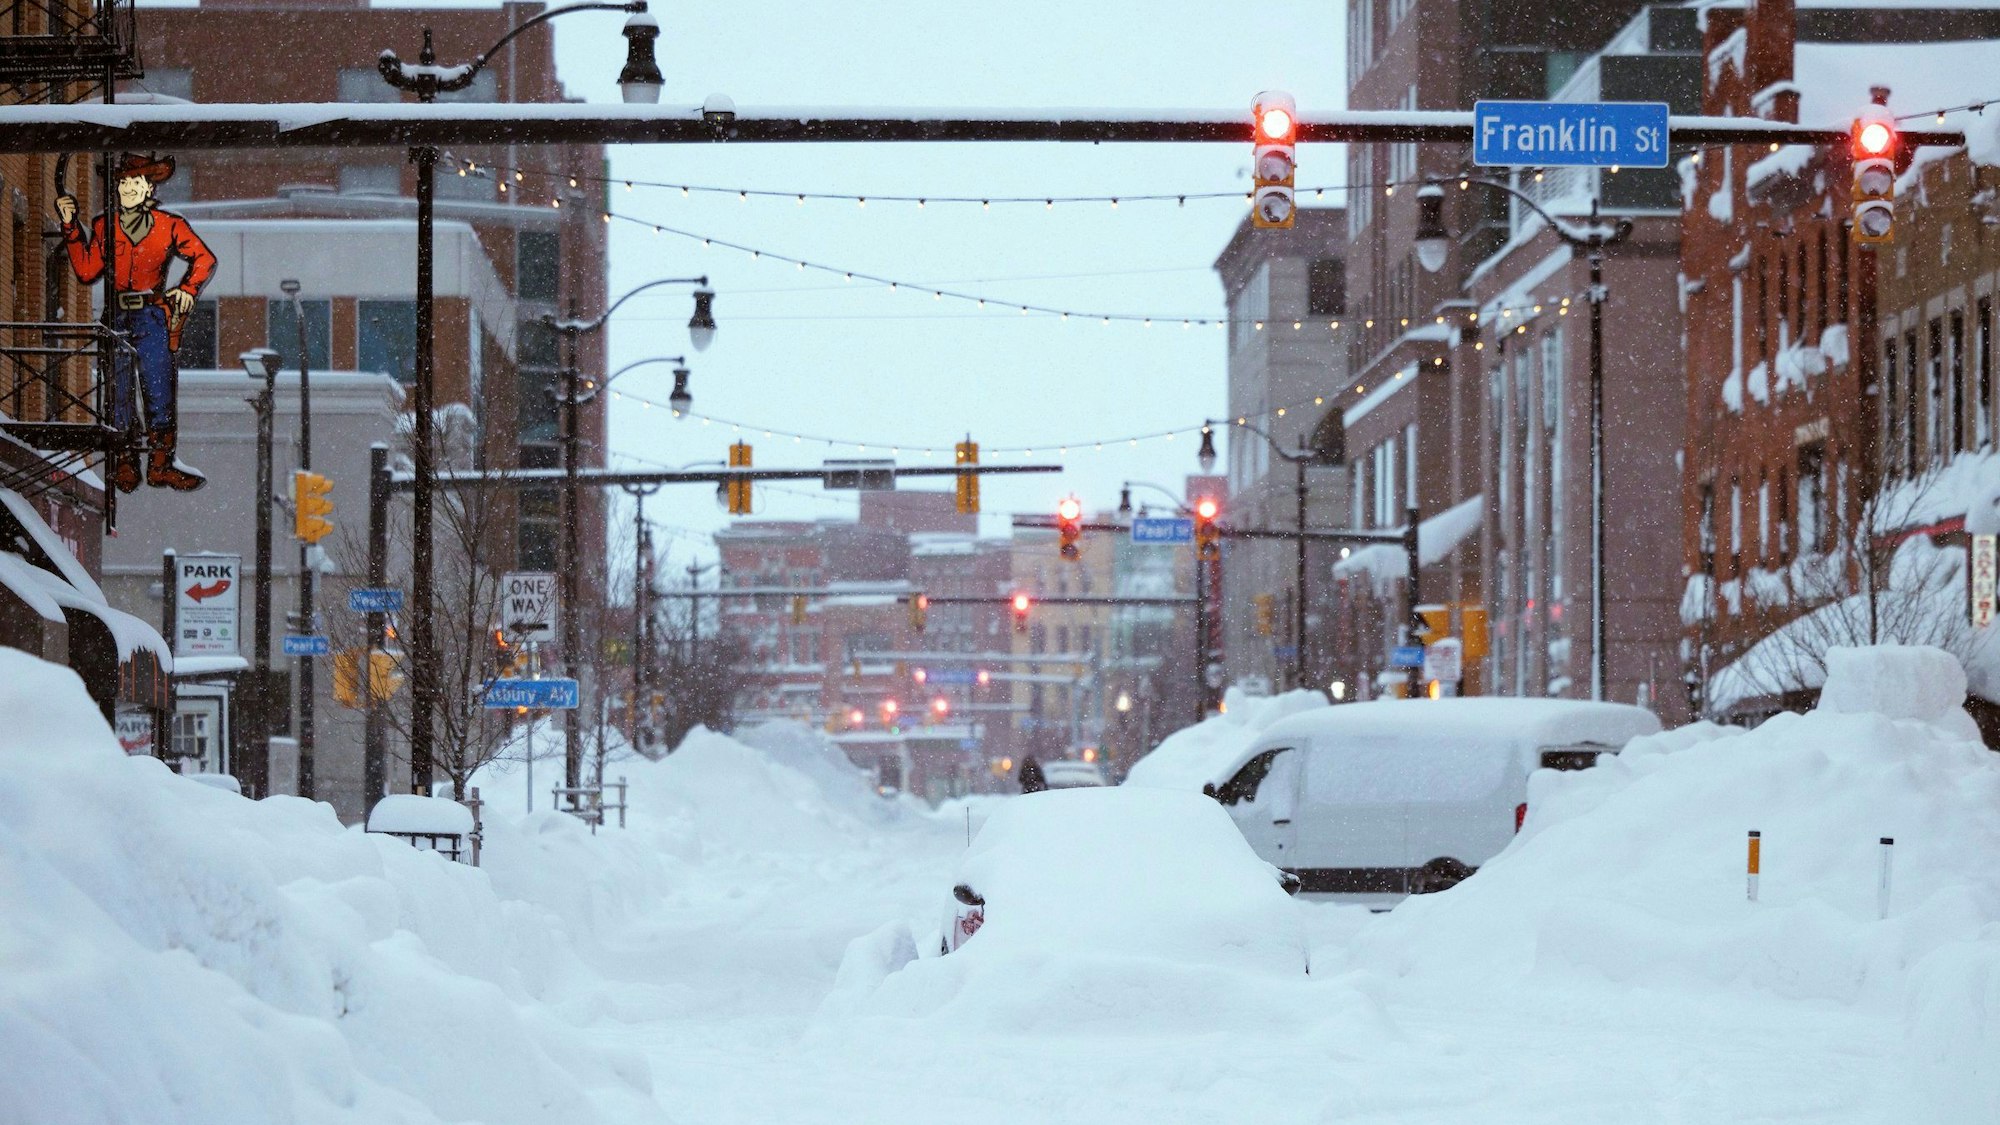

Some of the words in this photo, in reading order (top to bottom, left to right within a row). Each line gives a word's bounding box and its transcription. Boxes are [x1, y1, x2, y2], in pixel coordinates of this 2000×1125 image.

[1482, 116, 1617, 152] Franklin
[1635, 126, 1660, 153] St
[1137, 523, 1173, 538] Pearl
[184, 565, 232, 578] PARK
[511, 580, 547, 595] ONE
[512, 599, 546, 613] WAY
[285, 638, 314, 651] Pearl
[486, 688, 536, 704] Asbury
[550, 686, 573, 706] Aly
